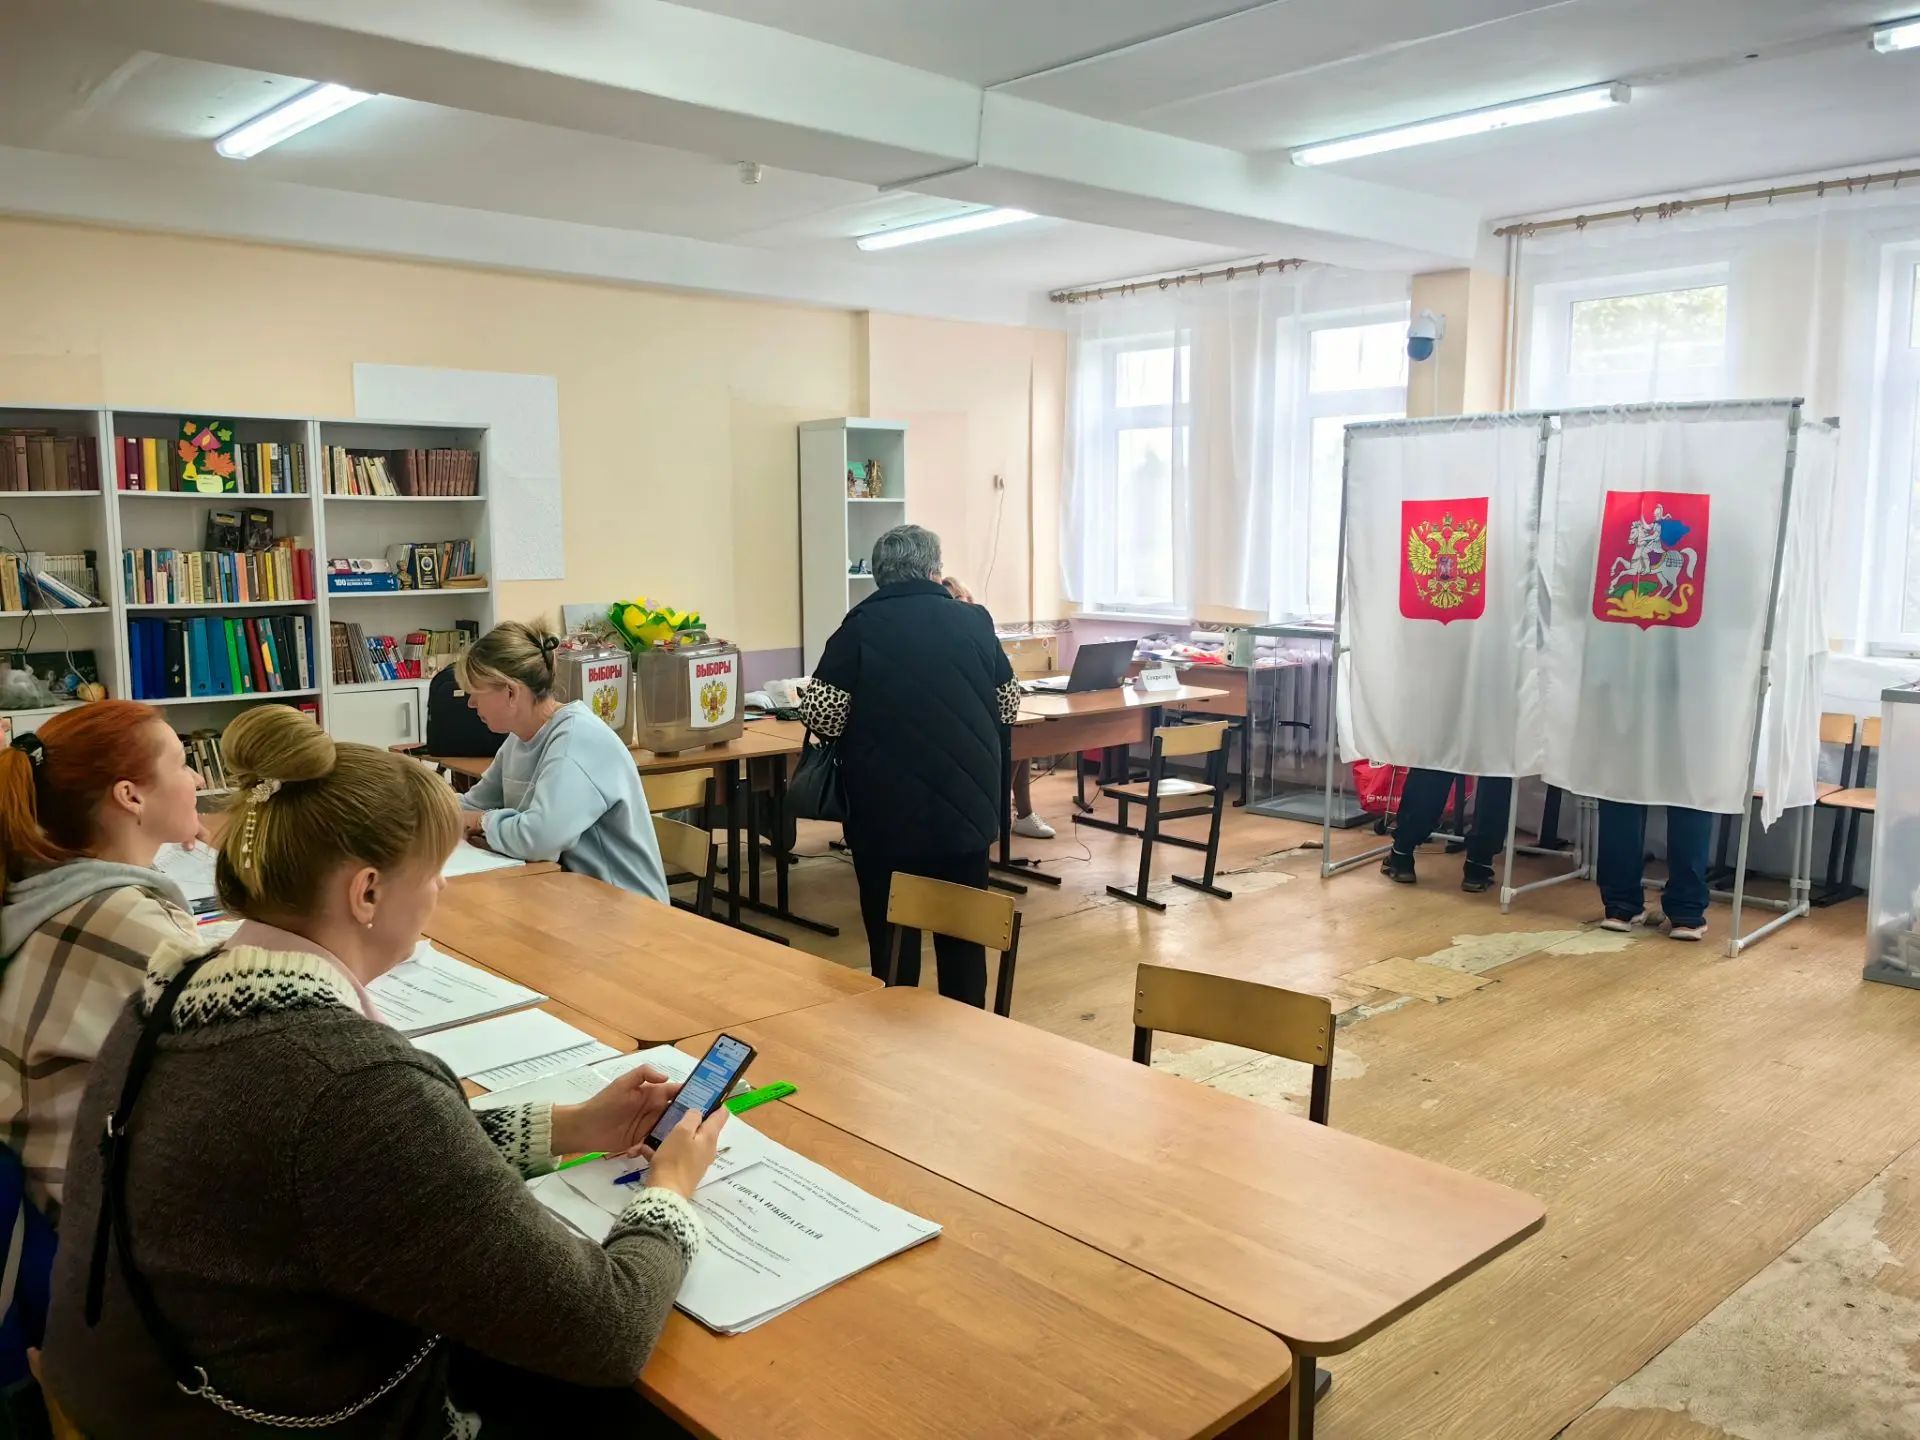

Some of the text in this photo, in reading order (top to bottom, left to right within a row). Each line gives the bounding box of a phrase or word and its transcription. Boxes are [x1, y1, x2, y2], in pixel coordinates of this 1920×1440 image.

[588, 664, 623, 682] ВЫБОРЫ
[695, 660, 732, 678] ВЫБОРЫ
[763, 1201, 824, 1240] ИЗБИРАТЕЛЕЙ
